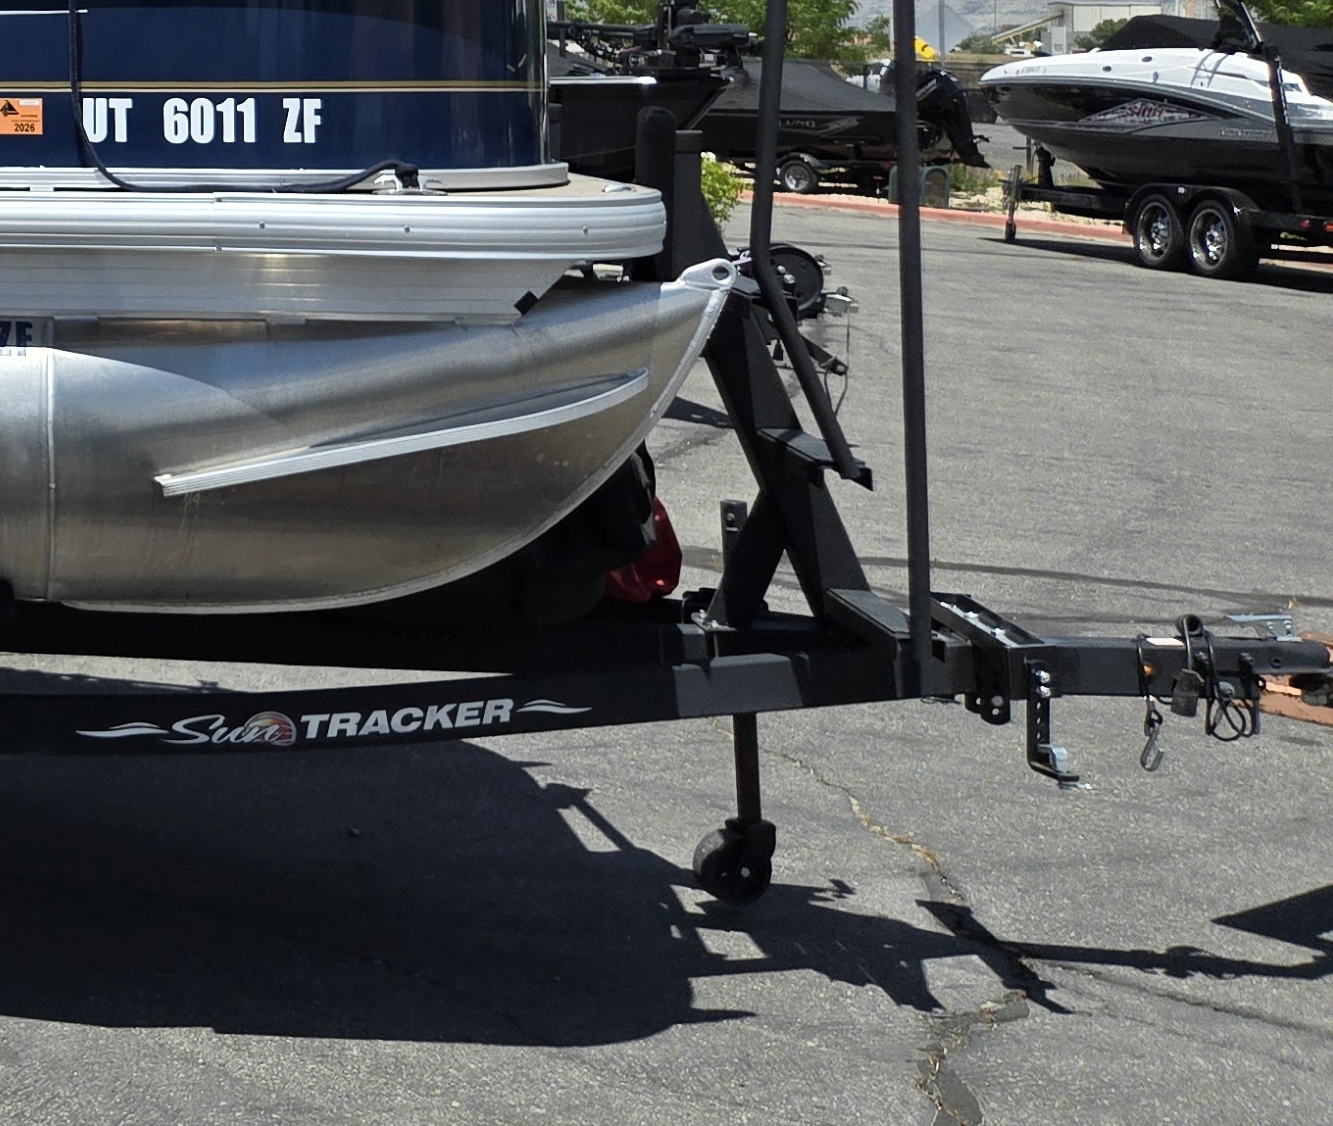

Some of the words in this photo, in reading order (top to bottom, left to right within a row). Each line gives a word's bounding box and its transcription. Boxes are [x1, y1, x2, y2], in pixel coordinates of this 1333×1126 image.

[14, 122, 36, 133] 2026
[82, 97, 133, 143] UT
[162, 97, 257, 145] 6011
[282, 97, 323, 144] ZF
[159, 714, 284, 745] Sun
[299, 698, 515, 740] TRACKER
